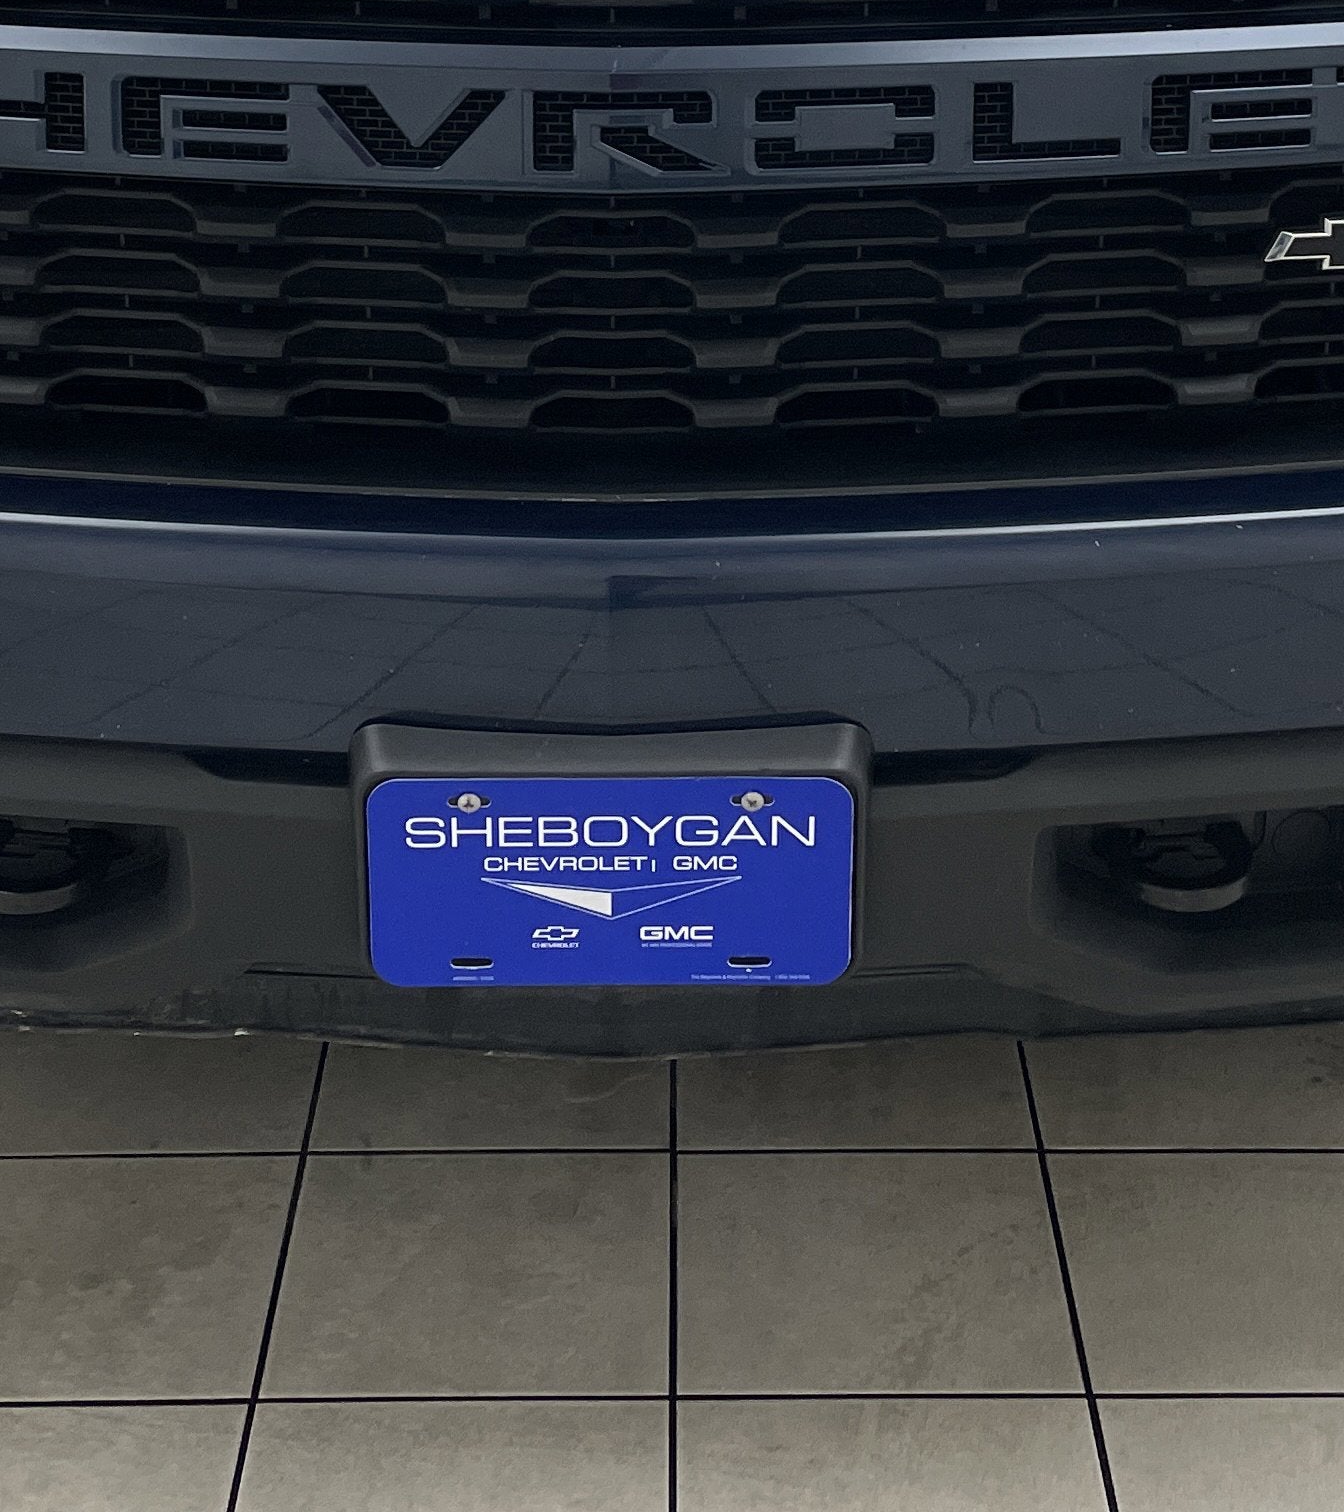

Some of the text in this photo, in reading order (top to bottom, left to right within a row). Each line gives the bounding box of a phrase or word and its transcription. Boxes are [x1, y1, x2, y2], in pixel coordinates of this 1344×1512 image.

[404, 814, 817, 849] SHEBOYGAN
[483, 854, 739, 872] CHEVROLET GMC
[639, 925, 714, 941] GMC
